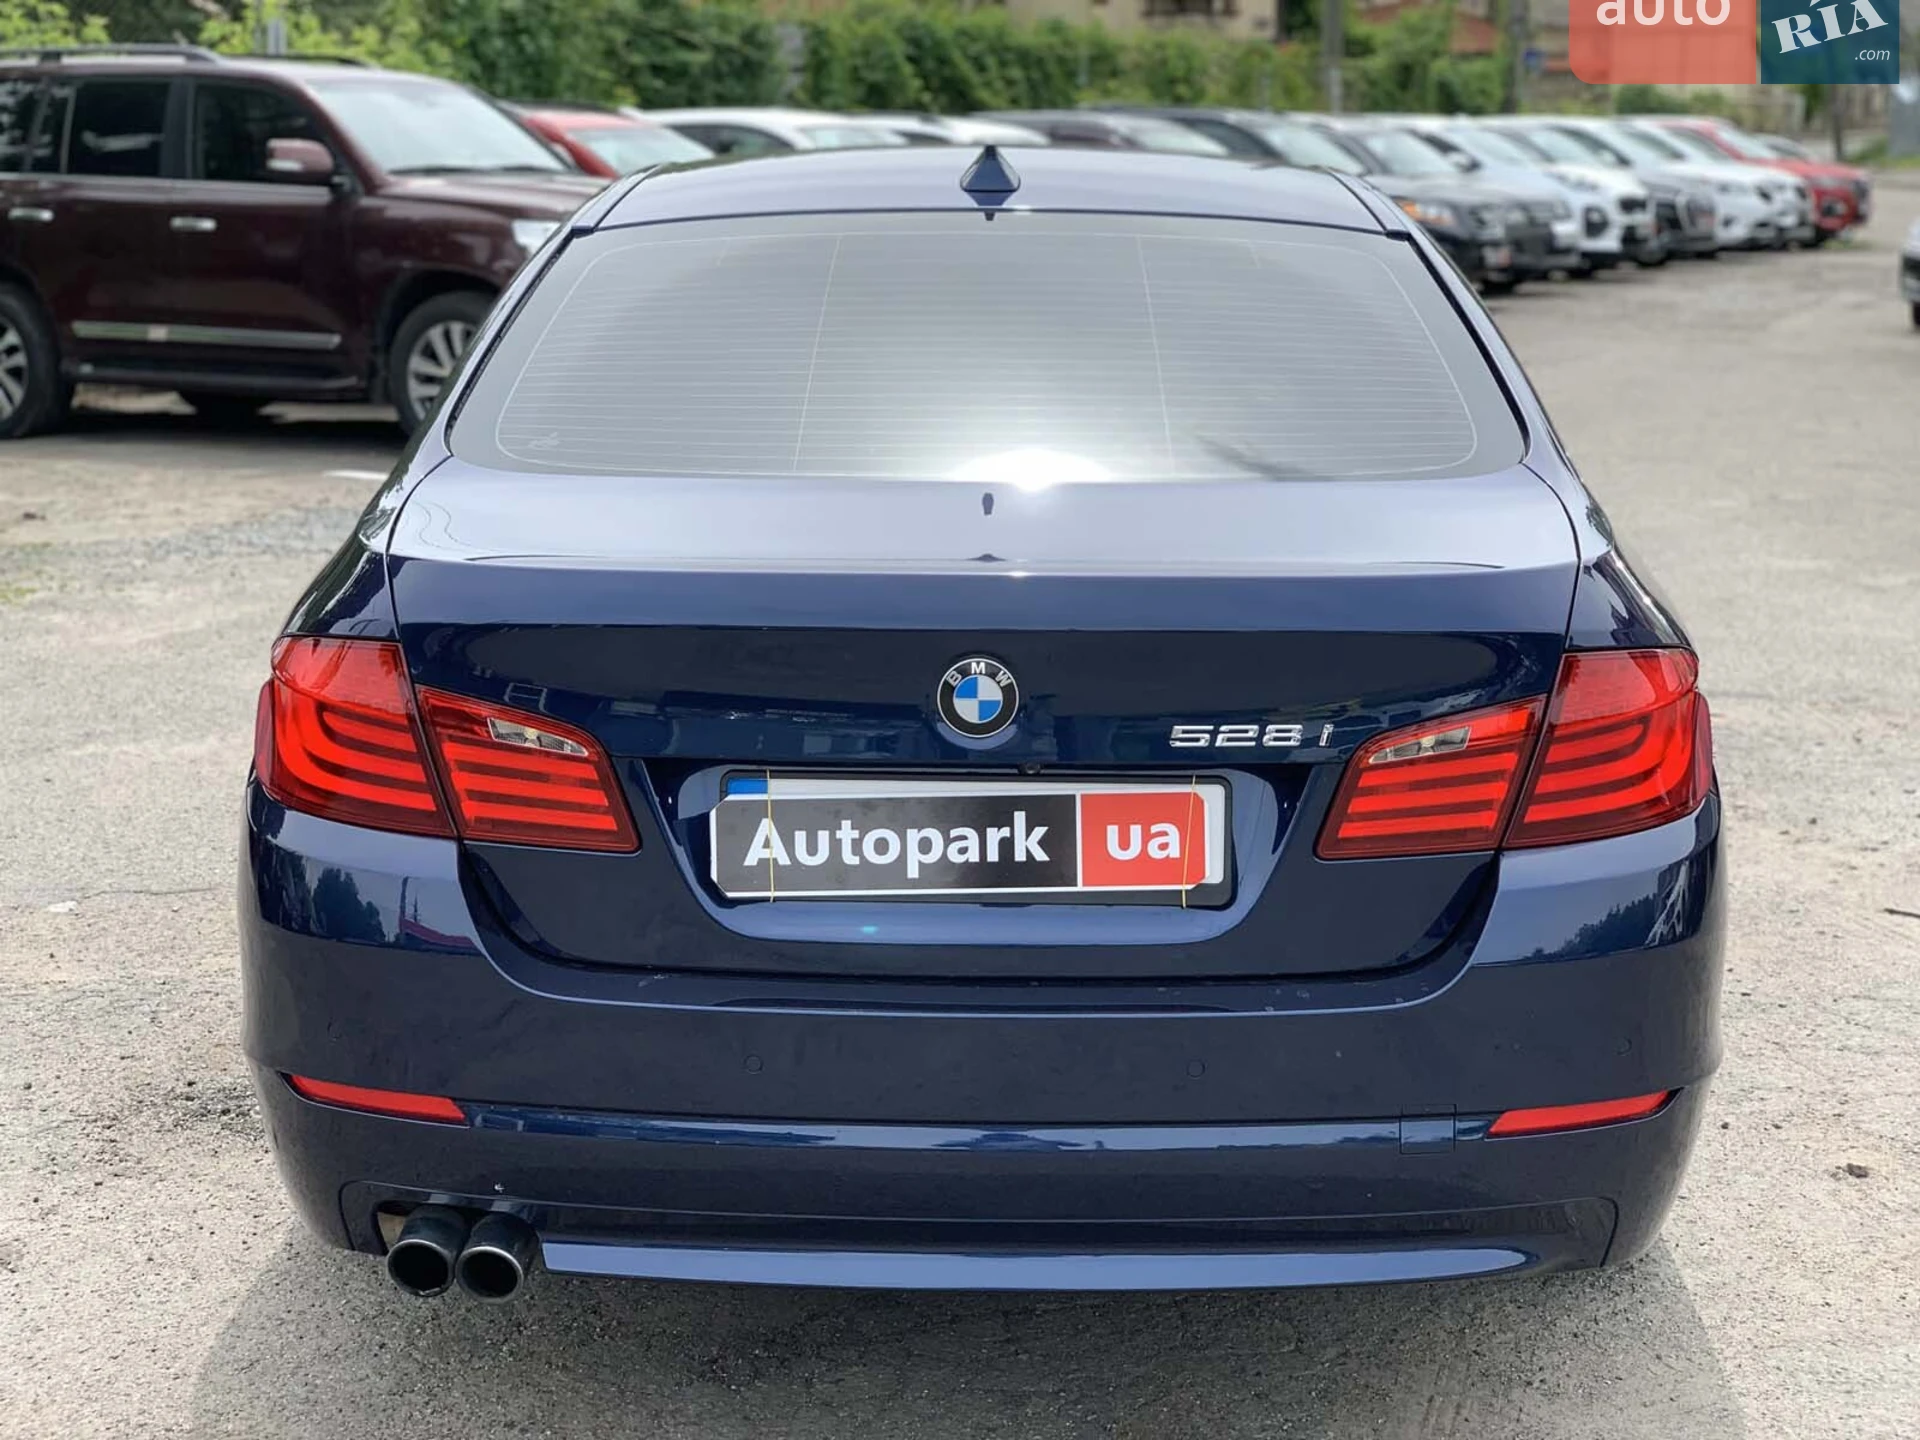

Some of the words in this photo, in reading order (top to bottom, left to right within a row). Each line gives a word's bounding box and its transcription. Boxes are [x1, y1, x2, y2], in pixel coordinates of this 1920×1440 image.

[945, 661, 1013, 688] BMW
[742, 810, 1050, 879] Autopark
[1106, 821, 1182, 861] ua
